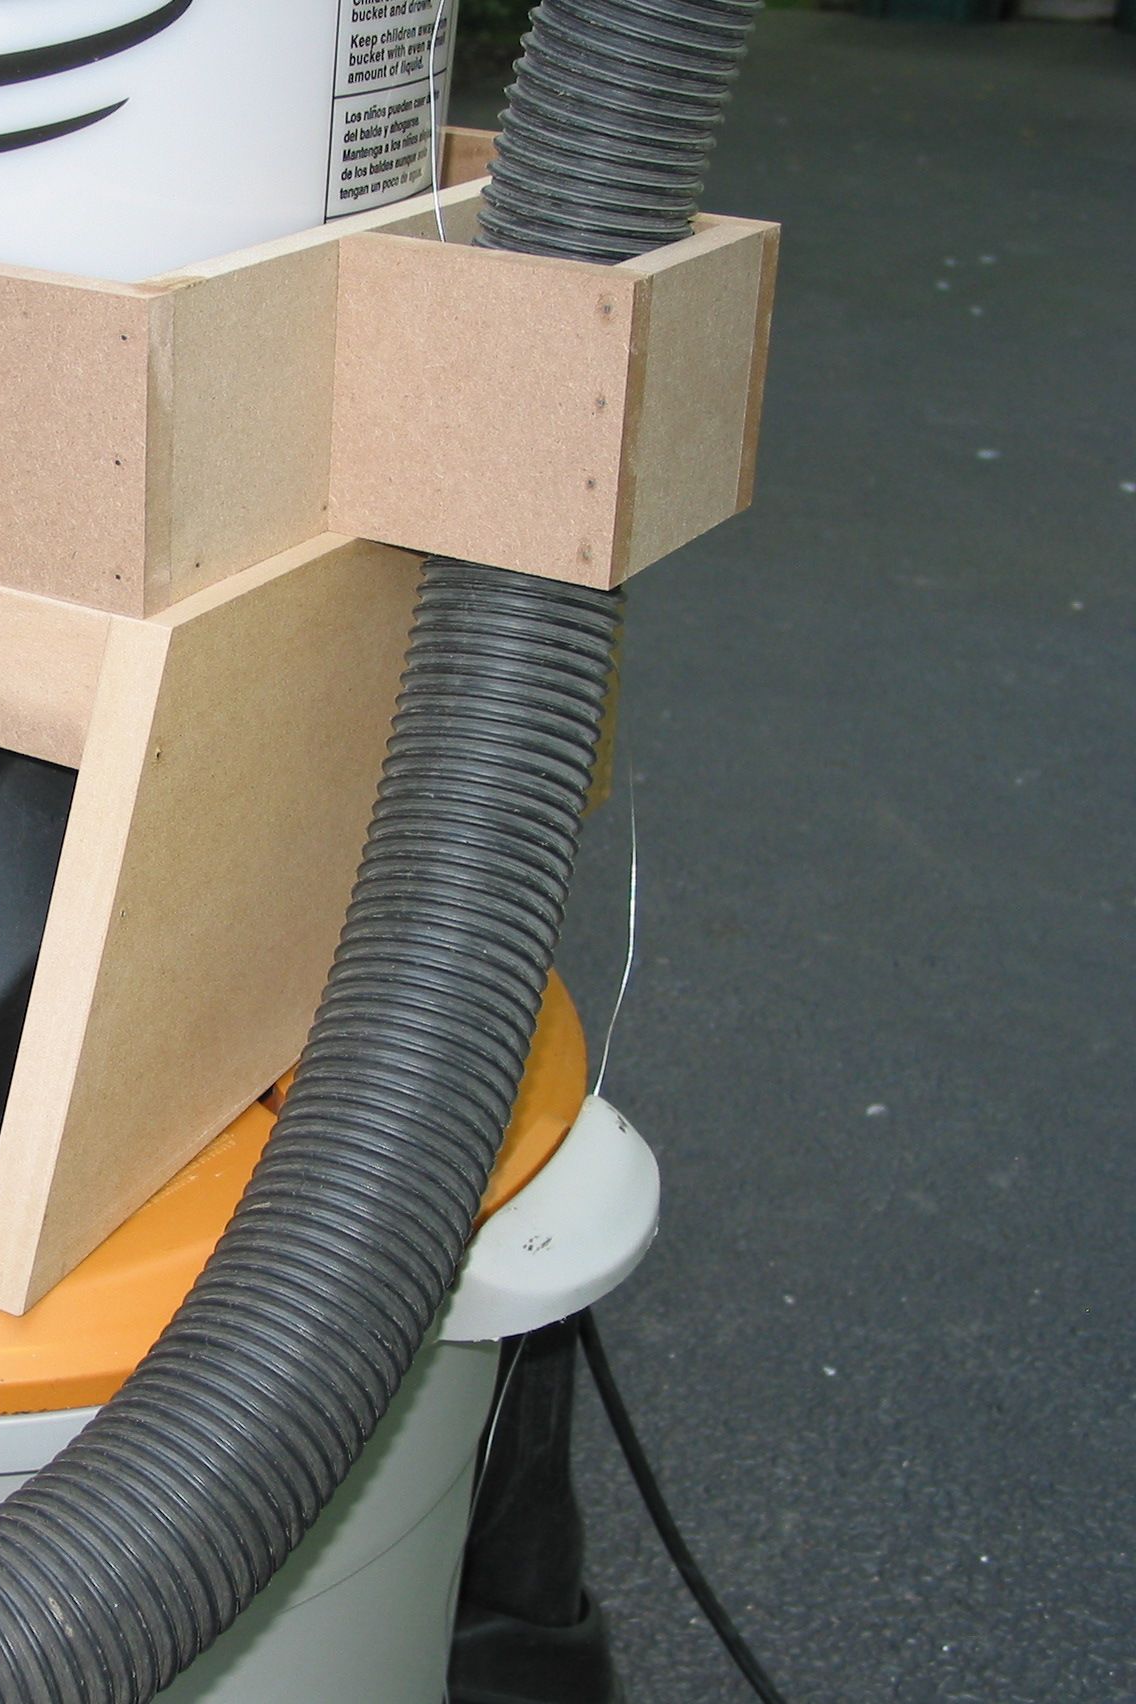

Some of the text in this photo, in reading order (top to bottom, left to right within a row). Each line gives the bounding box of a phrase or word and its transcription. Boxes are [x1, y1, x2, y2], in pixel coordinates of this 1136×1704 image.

[352, 5, 387, 22] bucket
[390, 3, 406, 17] and
[351, 34, 377, 50] Keep
[380, 26, 416, 44] children
[349, 49, 384, 66] bucket
[388, 43, 405, 59] with
[348, 65, 387, 83] amount
[389, 62, 399, 76] of
[345, 112, 362, 124] Los
[364, 104, 386, 121] niños
[344, 128, 357, 143] del
[360, 125, 382, 140] balde
[384, 125, 389, 138] y
[342, 145, 382, 162] Mantenga
[384, 143, 389, 153] a
[390, 140, 401, 152] los
[341, 168, 352, 180] de
[354, 166, 367, 178] los
[369, 159, 394, 175] baldes
[340, 185, 369, 200] tengan
[371, 181, 381, 193] un
[382, 176, 399, 192] poco
